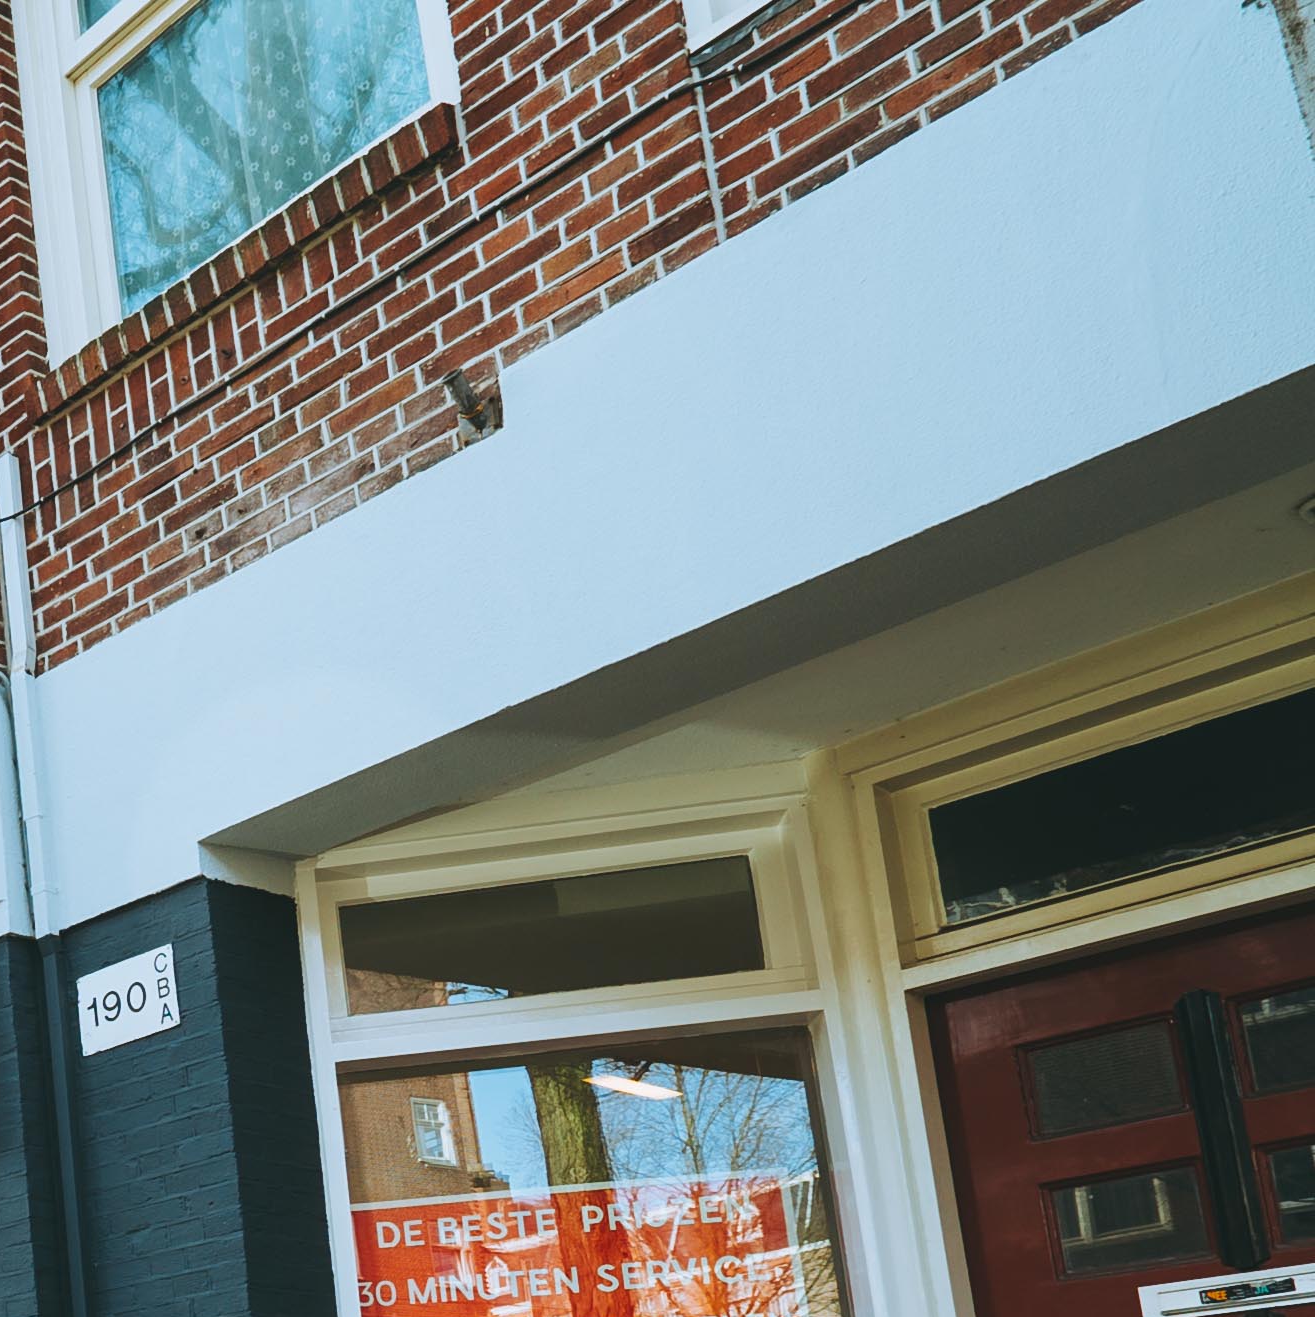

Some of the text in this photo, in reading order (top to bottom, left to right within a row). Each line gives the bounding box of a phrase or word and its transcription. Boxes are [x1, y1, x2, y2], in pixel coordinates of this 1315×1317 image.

[87, 952, 168, 1027] 190 C
[157, 977, 170, 999] B
[161, 1003, 174, 1025] A
[375, 1194, 753, 1249] DE BESTE PRIJZEN
[358, 1280, 397, 1307] 30
[407, 1266, 580, 1305] MINUTEN
